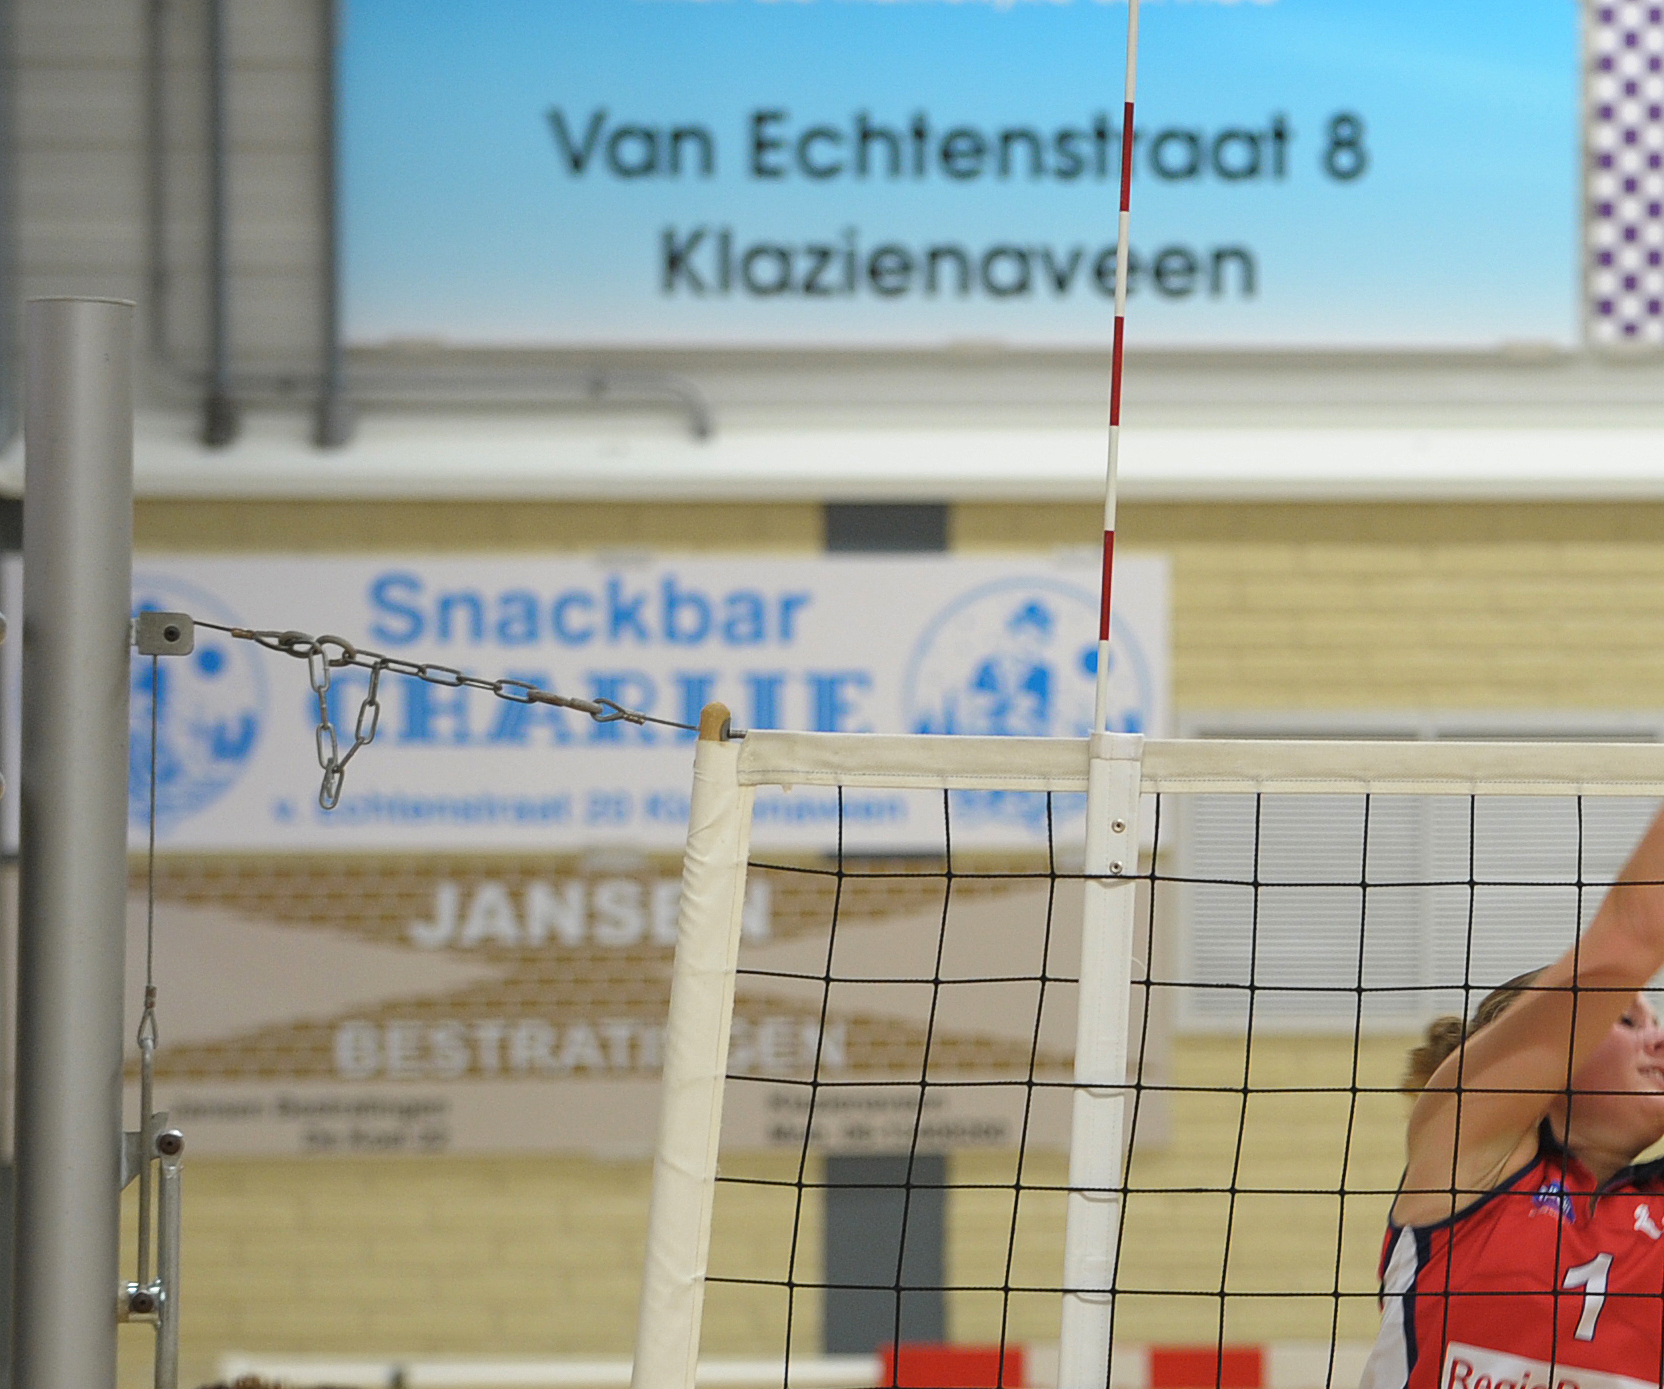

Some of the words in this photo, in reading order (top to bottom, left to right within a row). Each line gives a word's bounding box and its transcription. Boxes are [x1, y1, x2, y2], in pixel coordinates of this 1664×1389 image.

[547, 107, 714, 183] Van
[748, 105, 1293, 186] Echtenstraat
[1319, 114, 1369, 183] 8
[661, 223, 1258, 300] Klazienaveen
[366, 573, 814, 646] Snackbar
[333, 1018, 850, 1079] BESTRATIGEN
[1562, 1252, 1614, 1341] 1
